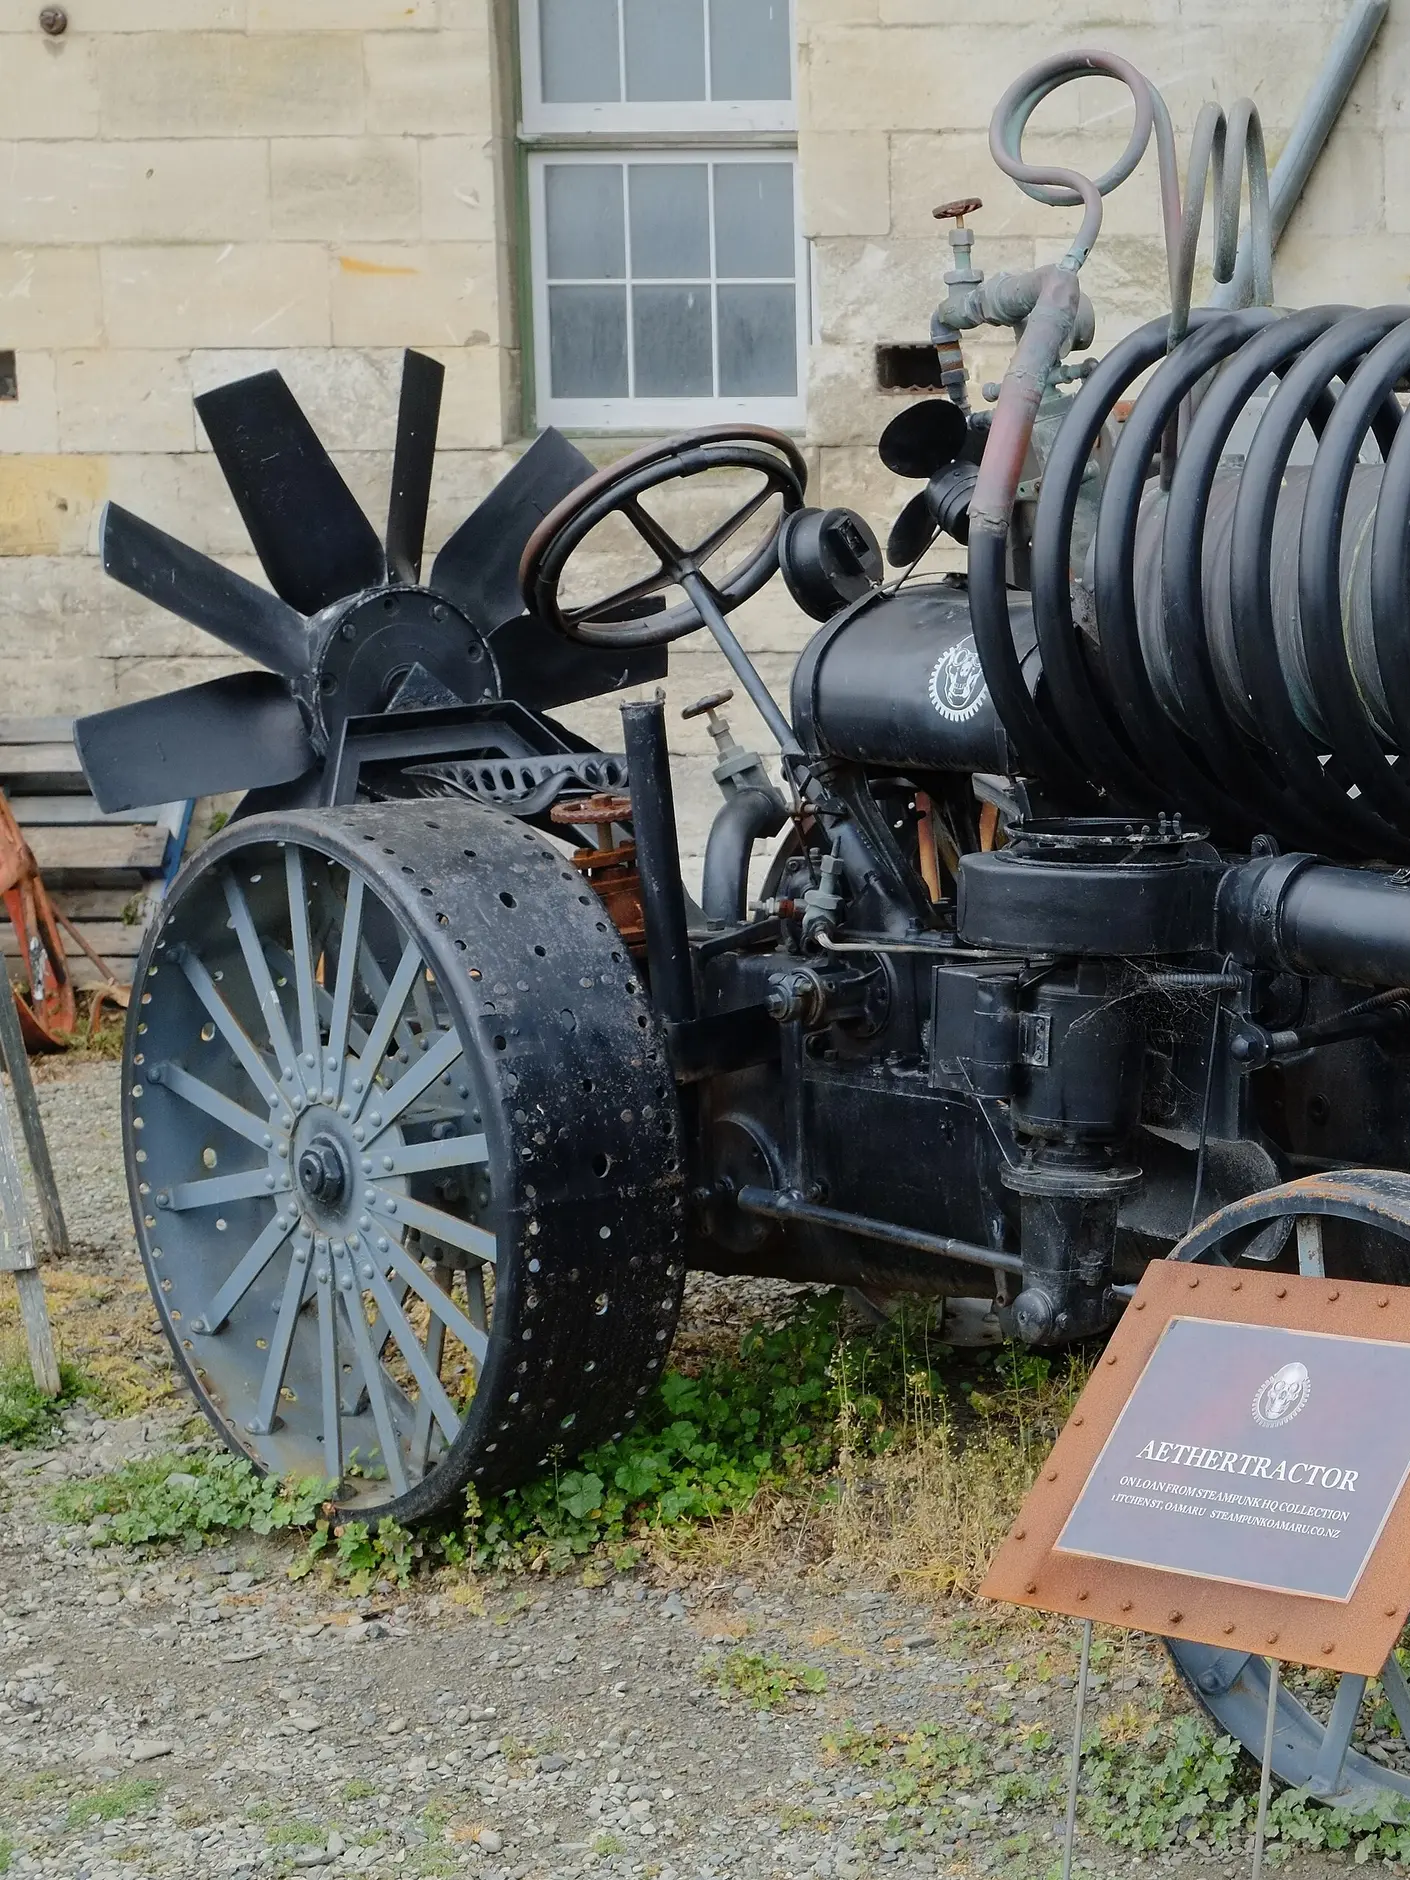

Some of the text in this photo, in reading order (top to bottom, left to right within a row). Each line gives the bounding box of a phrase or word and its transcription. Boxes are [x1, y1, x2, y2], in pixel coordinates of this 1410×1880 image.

[1136, 1439, 1360, 1493] AETHERTRACTOR
[1115, 1493, 1153, 1507] ITCHEN
[1164, 1502, 1207, 1516] OAMARU
[1209, 1509, 1341, 1539] STEAMPUNKOAMARU.CO.NZ
[1119, 1475, 1350, 1522] ON LOAN FROM STEAMPUNK HQ COLLECTION
